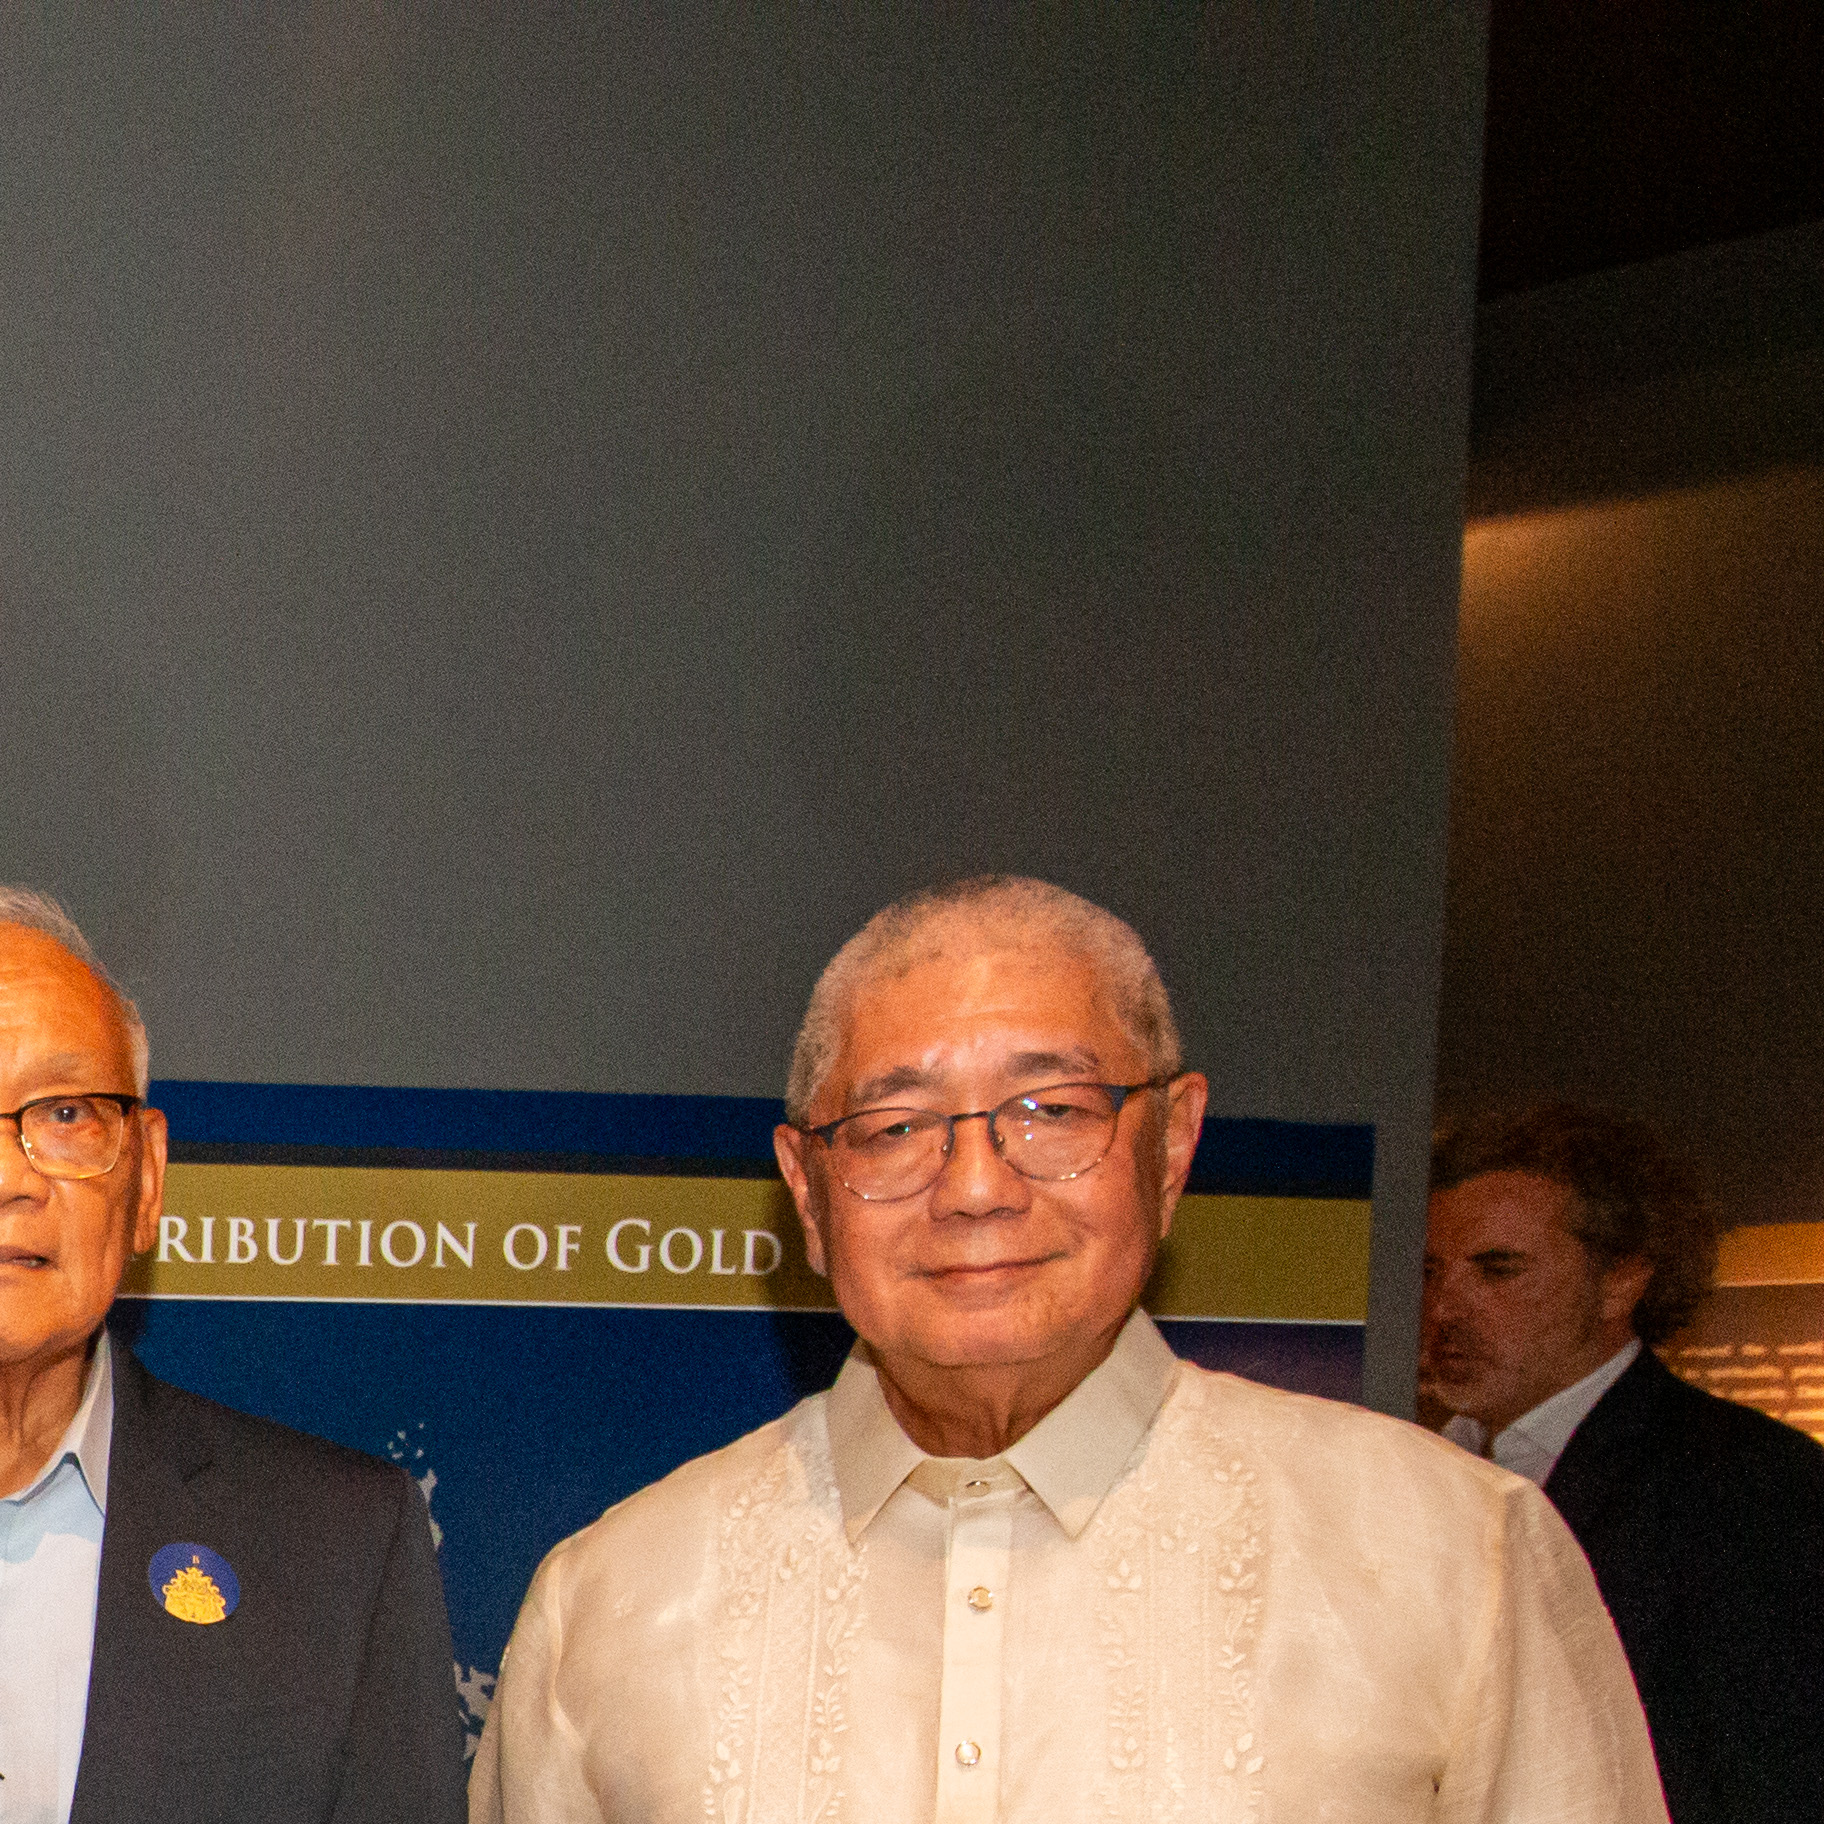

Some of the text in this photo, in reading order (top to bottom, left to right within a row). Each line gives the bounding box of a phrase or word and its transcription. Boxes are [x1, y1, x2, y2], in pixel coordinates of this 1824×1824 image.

[130, 1214, 782, 1276] RIBUTION OF GOLD
